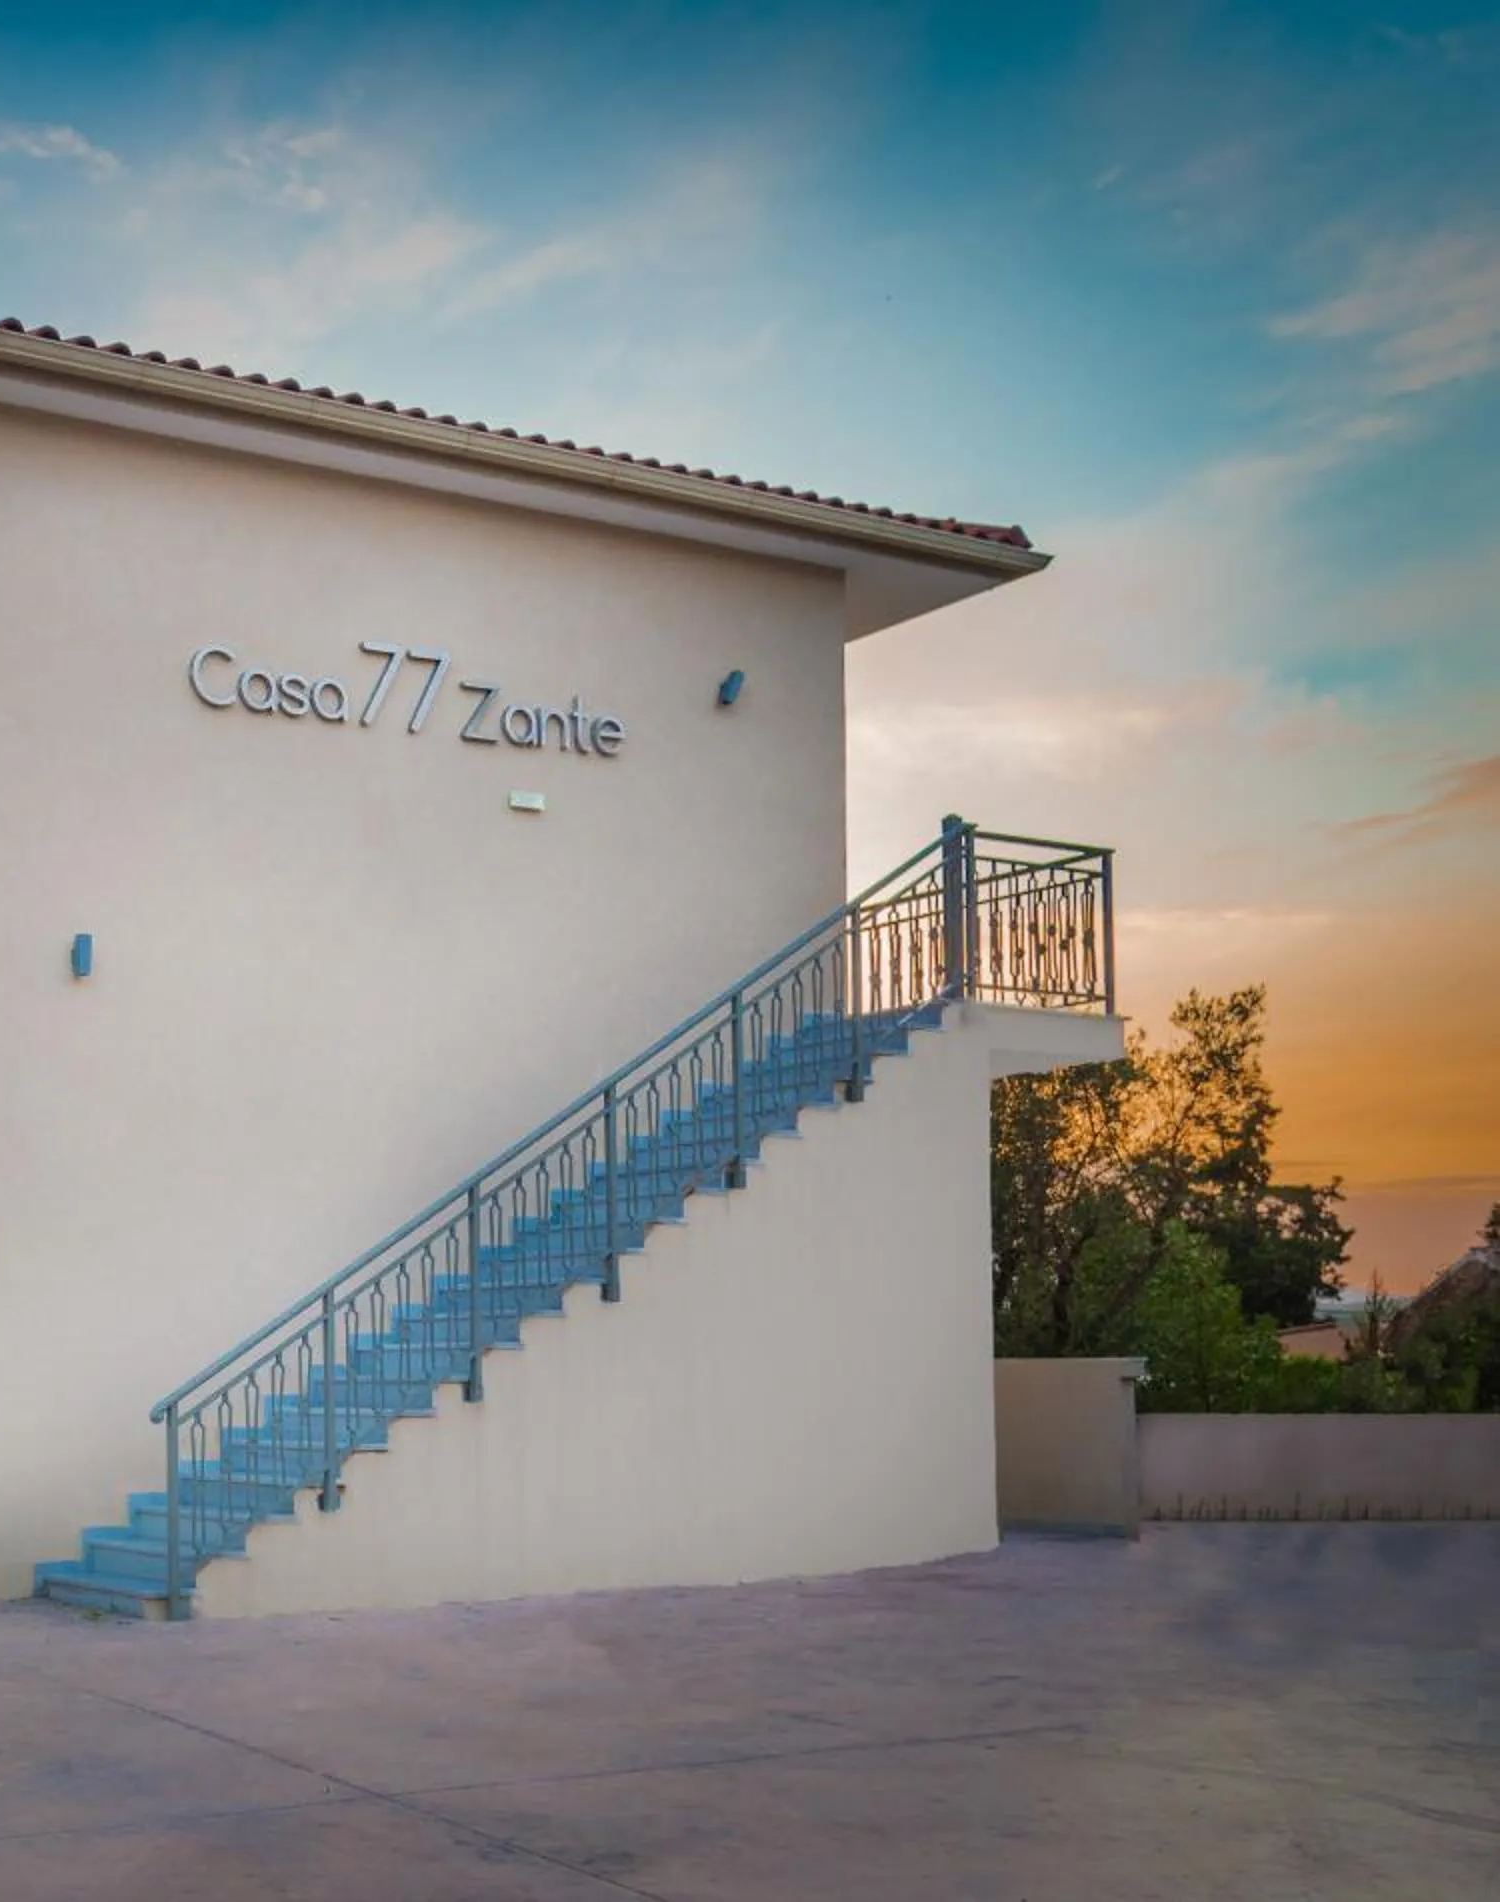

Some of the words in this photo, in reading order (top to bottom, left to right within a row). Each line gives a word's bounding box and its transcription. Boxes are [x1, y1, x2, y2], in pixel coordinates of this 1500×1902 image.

[189, 644, 347, 723] Casa
[359, 641, 451, 734] 77
[459, 680, 626, 757] Zante
